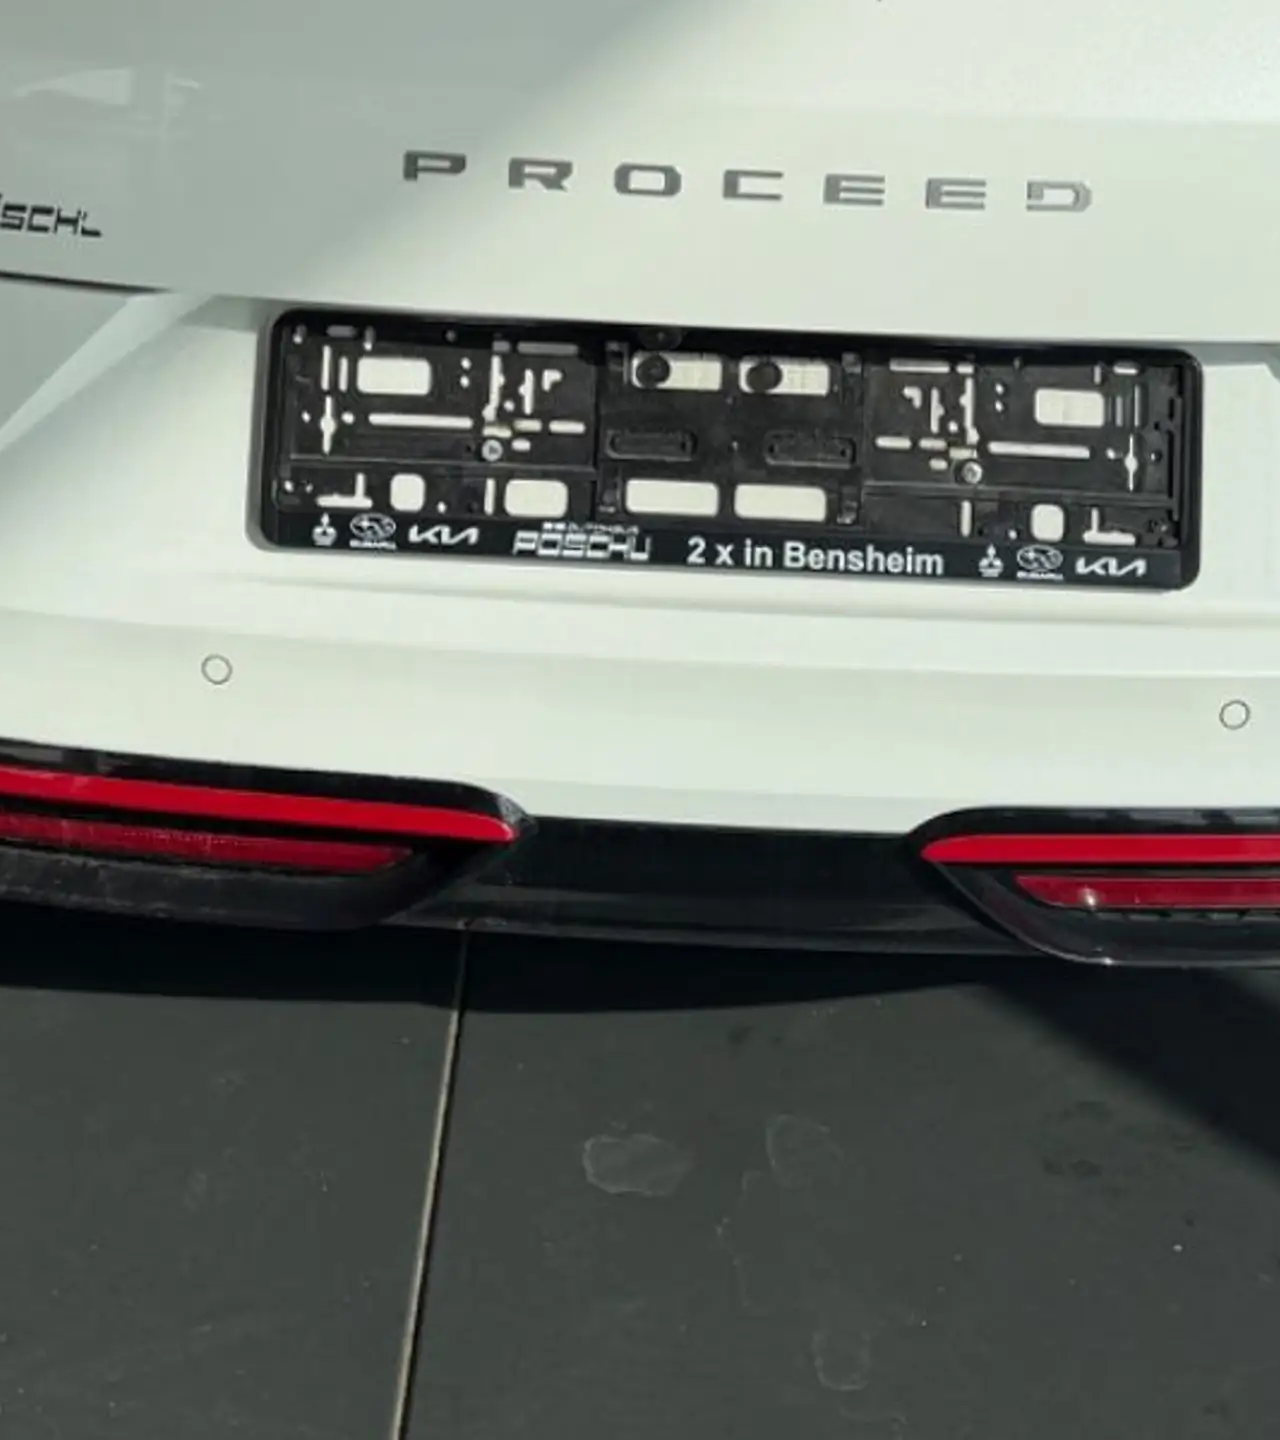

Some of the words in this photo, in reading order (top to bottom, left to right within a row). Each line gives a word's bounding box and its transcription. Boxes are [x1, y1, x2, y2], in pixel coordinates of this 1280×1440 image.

[402, 150, 1093, 212] PROCEED
[687, 537, 705, 566] 2
[716, 543, 735, 566] x
[744, 539, 773, 569] in
[783, 541, 945, 576] Bensheim
